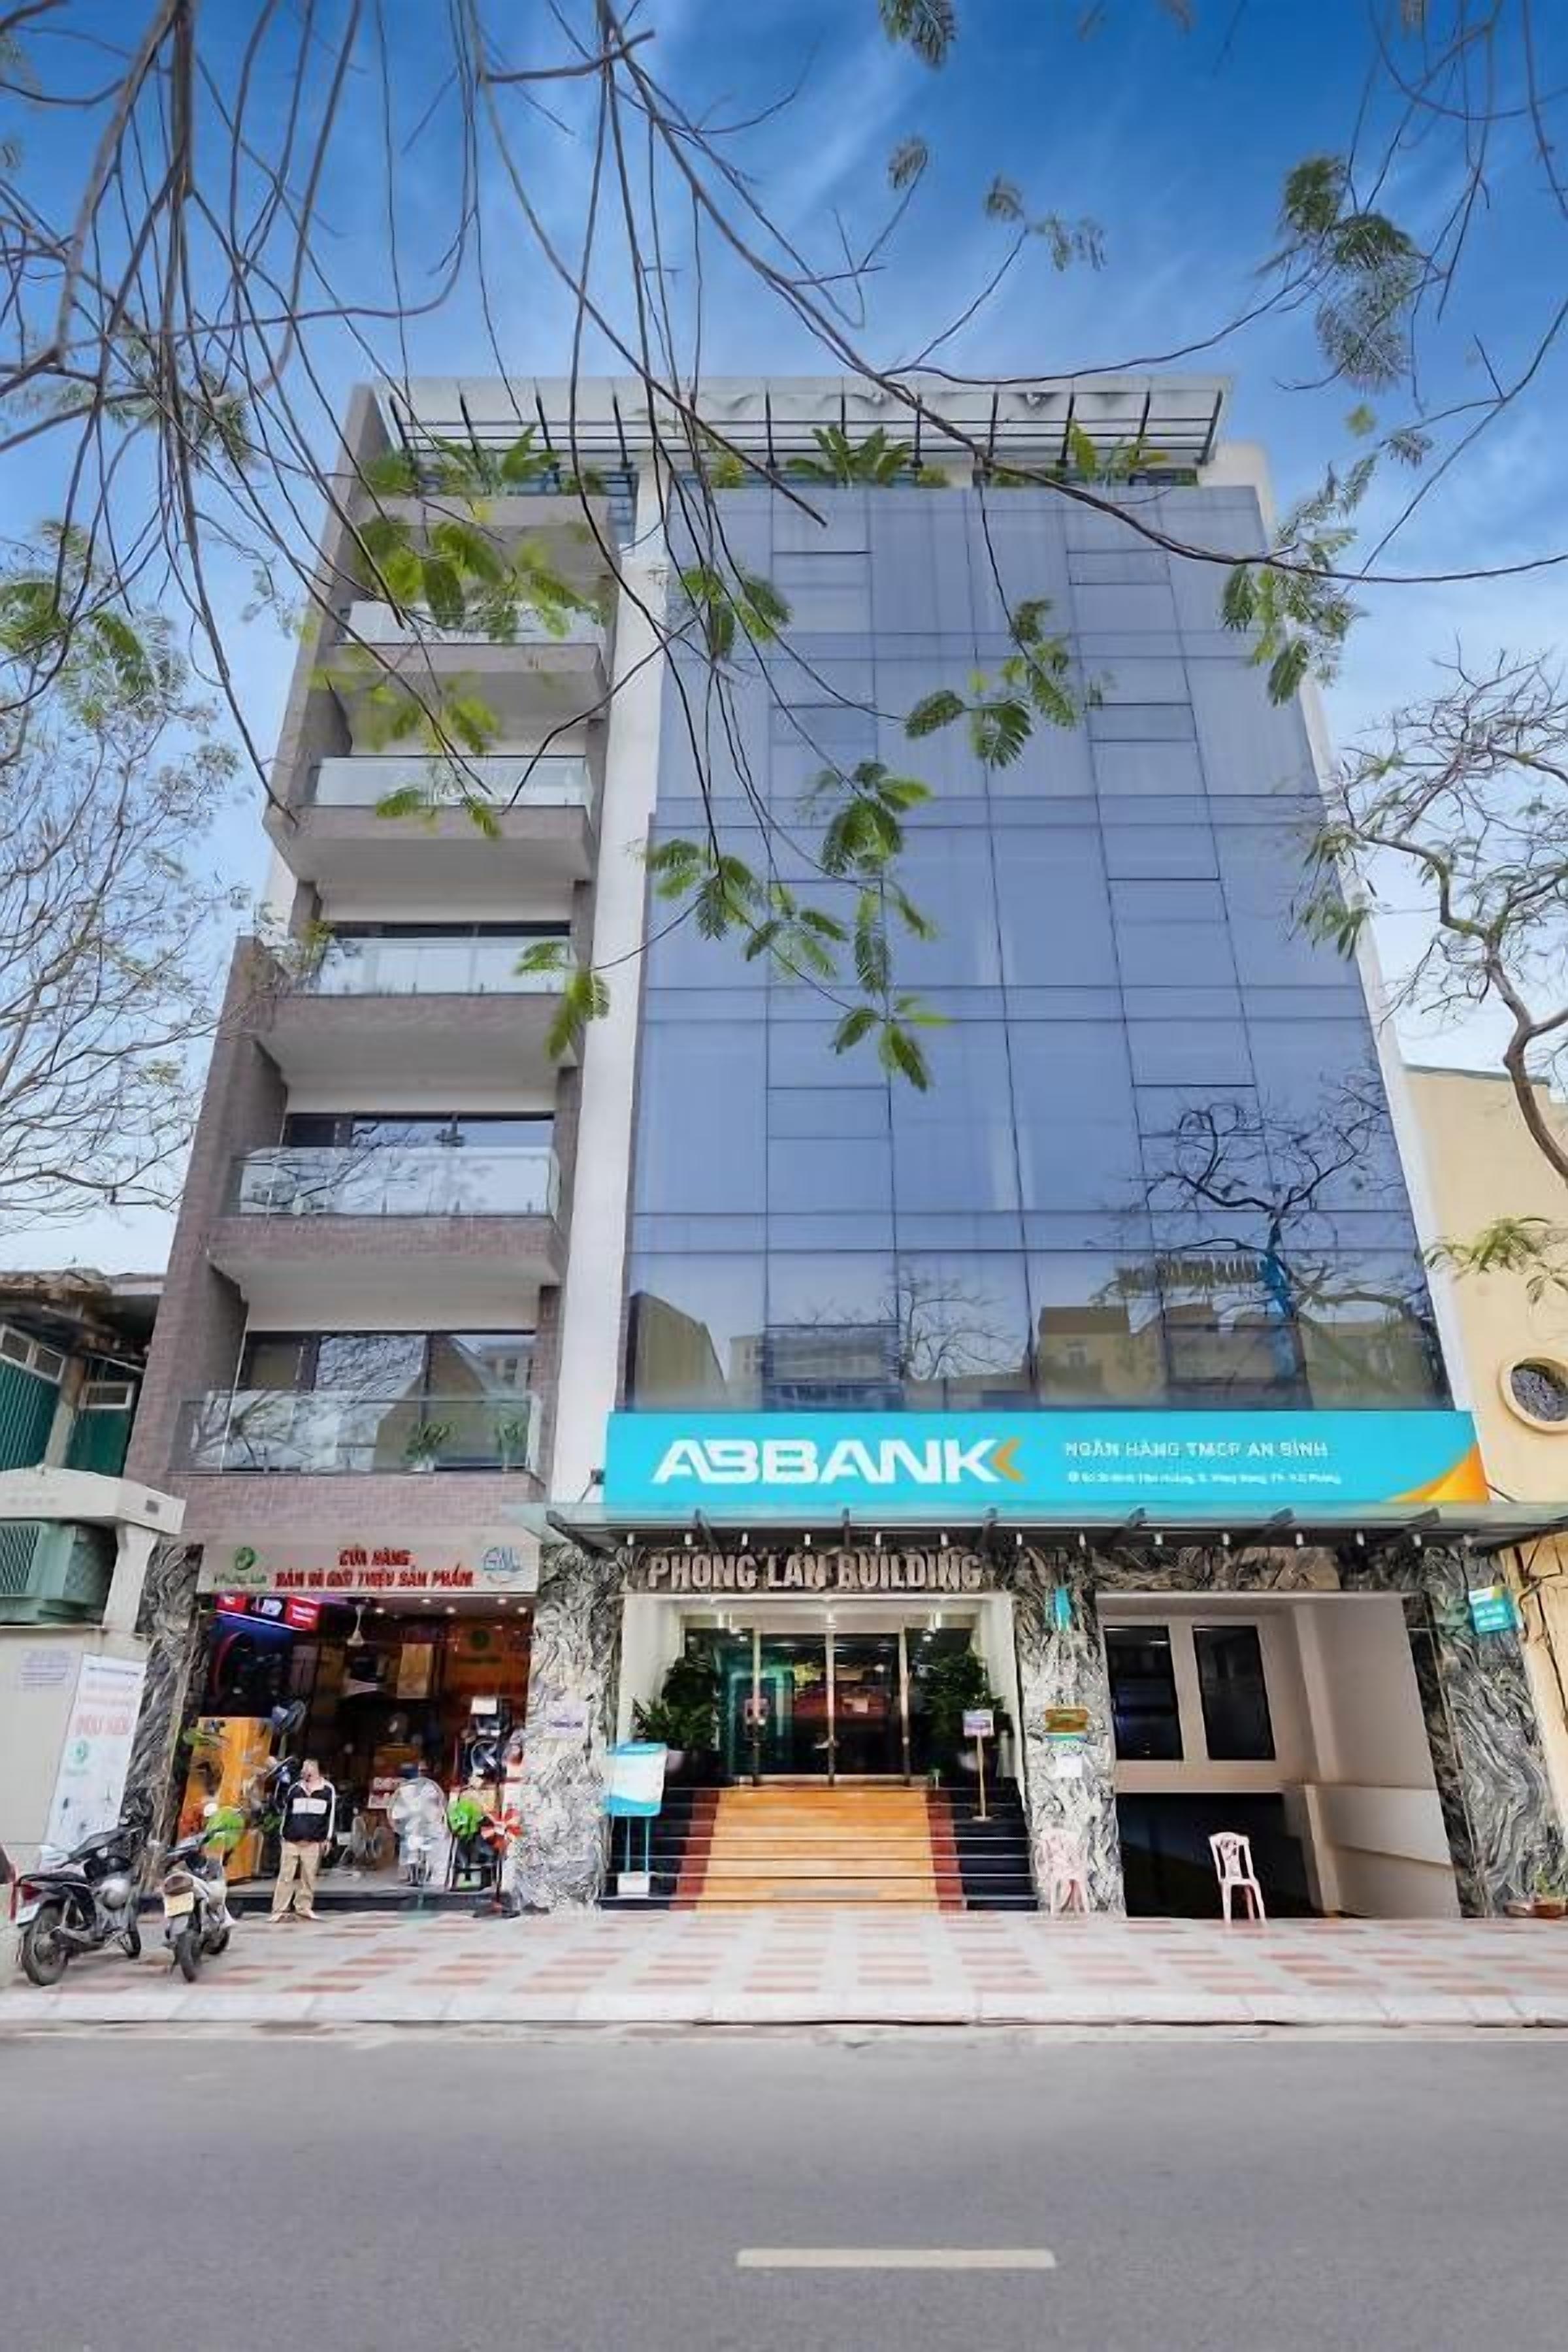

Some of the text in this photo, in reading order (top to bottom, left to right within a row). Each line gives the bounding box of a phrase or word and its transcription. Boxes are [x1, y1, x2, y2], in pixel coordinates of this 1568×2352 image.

[652, 1438, 1001, 1484] ABBANK
[1247, 1442, 1274, 1456] AN
[648, 1552, 982, 1590] PHONG LAN BUILDING
